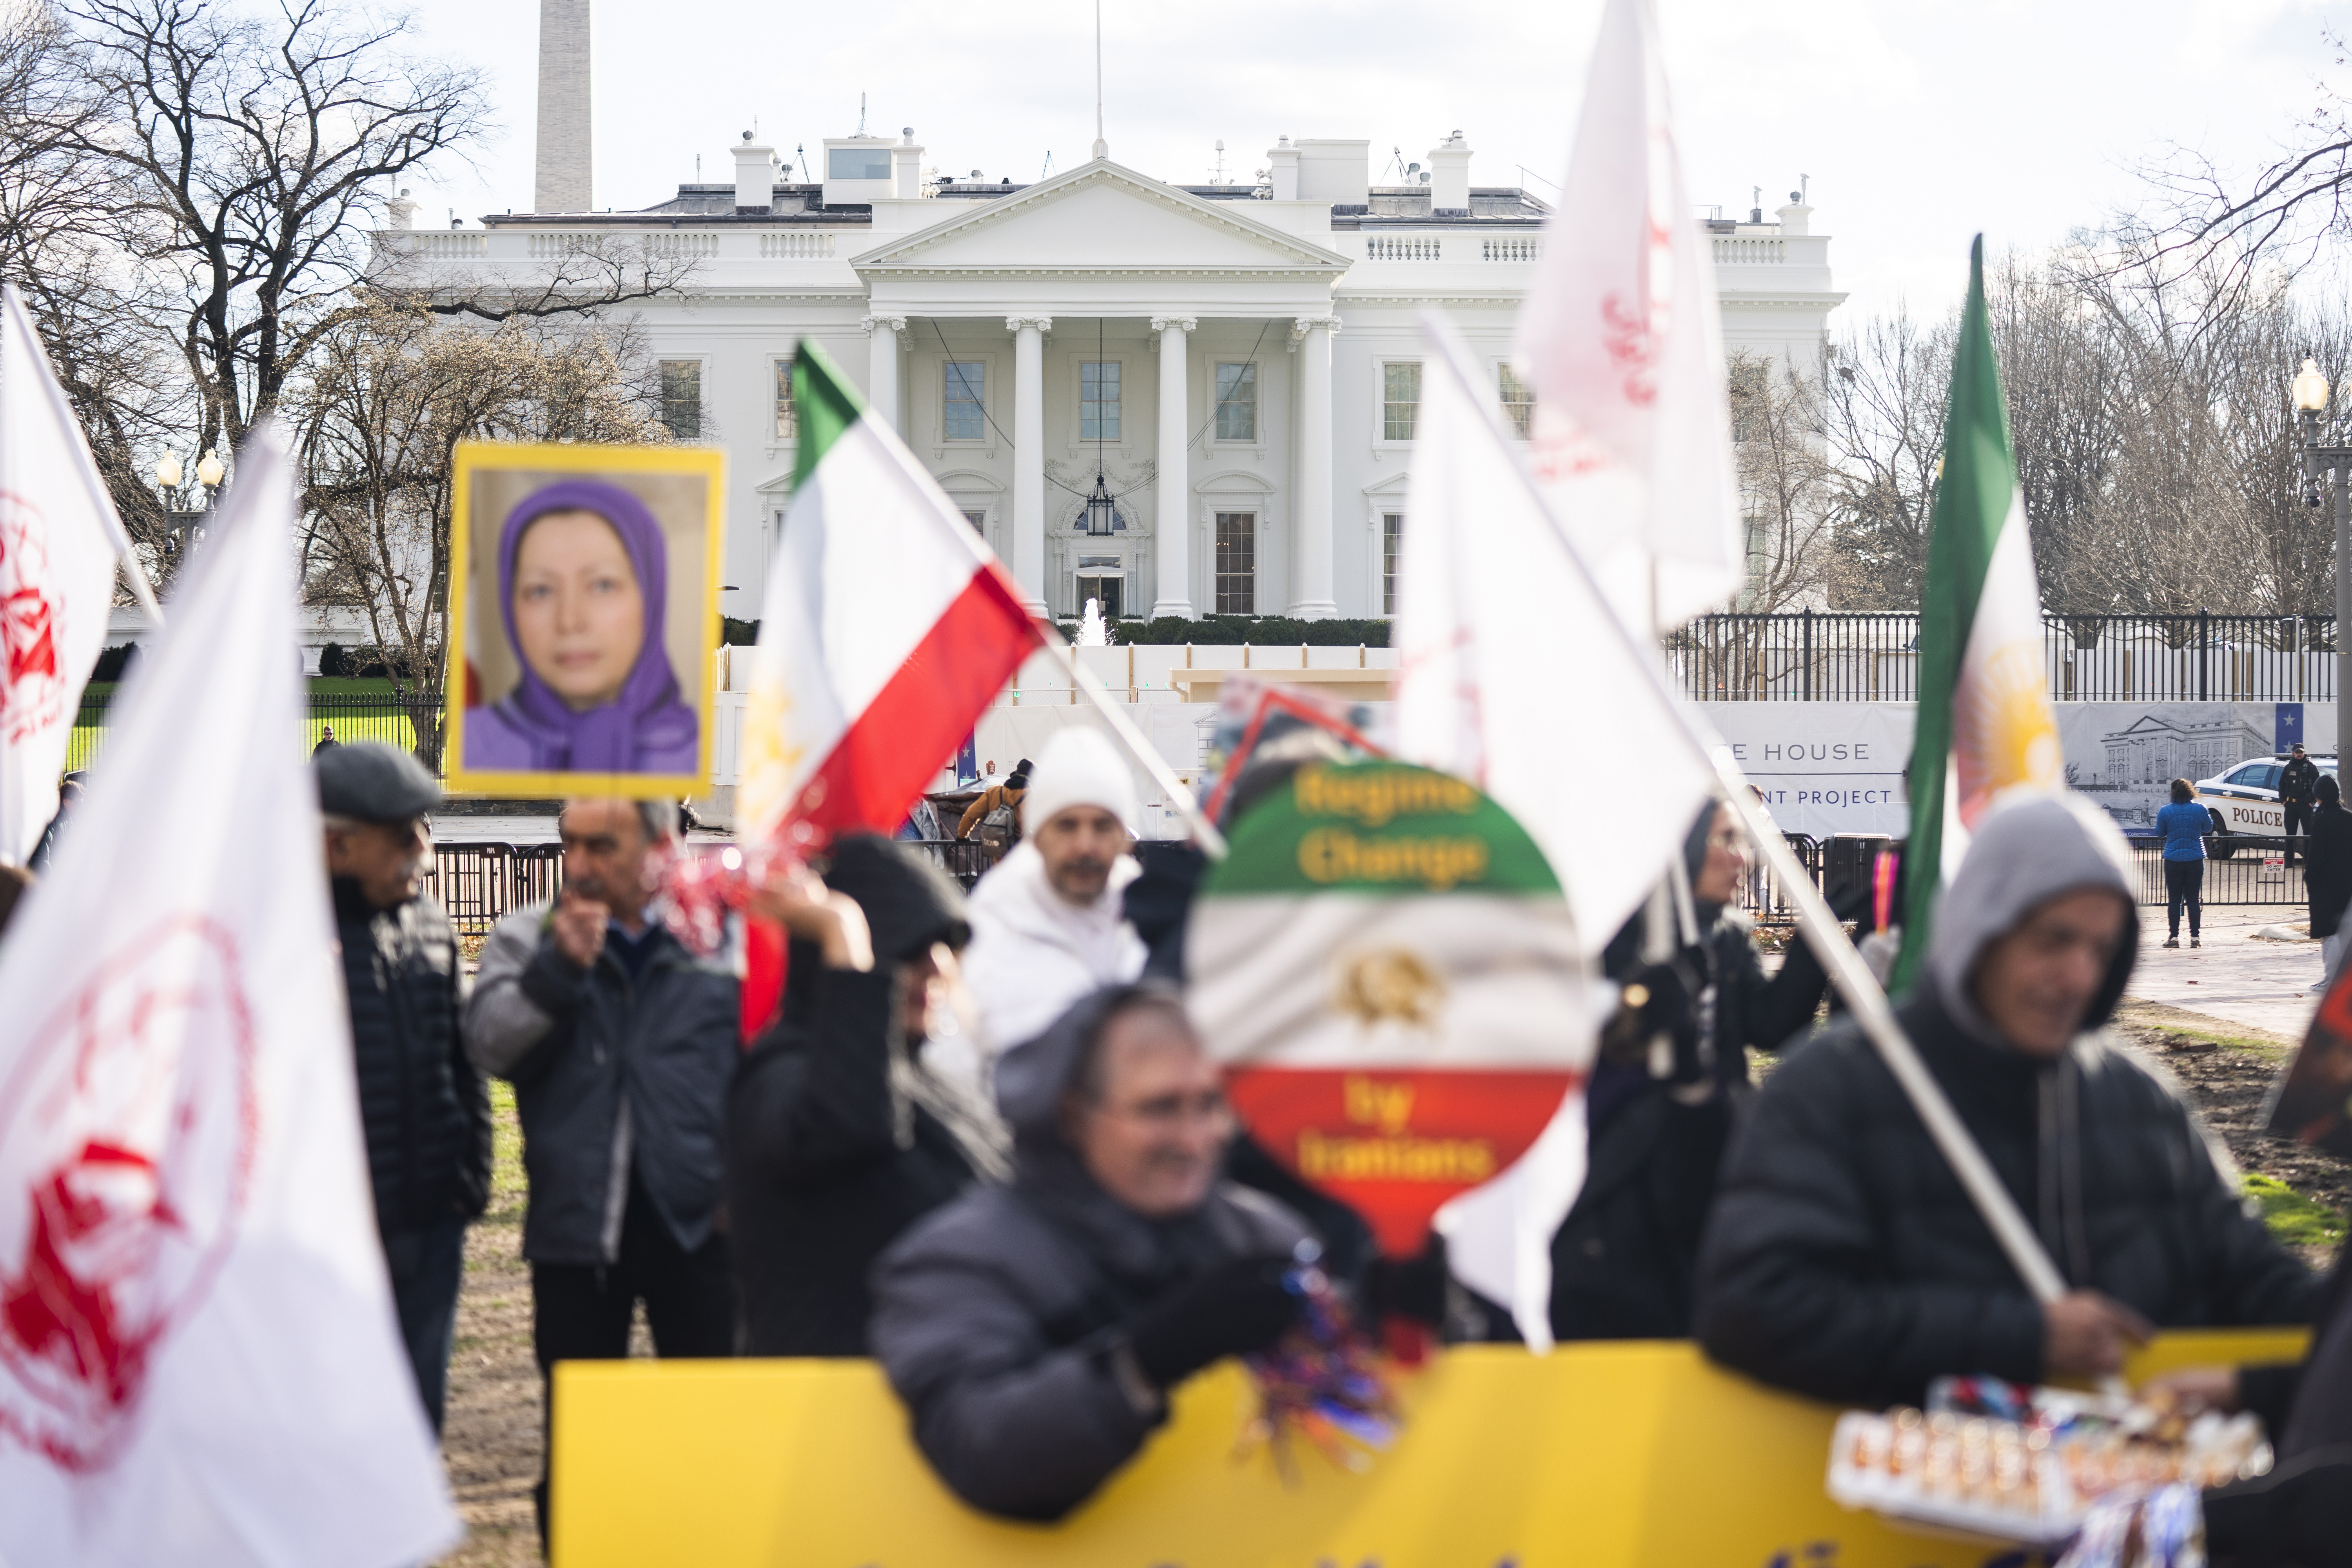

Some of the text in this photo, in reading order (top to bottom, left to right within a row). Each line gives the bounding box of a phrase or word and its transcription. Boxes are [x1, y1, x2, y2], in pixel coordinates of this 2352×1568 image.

[1764, 743, 1869, 760] HOUSE
[1294, 764, 1479, 826] Regime
[1798, 790, 1891, 808] PROJECT
[2232, 807, 2283, 827] POLICE
[1298, 827, 1488, 889] Change
[1343, 1073, 1414, 1134] by
[1299, 1130, 1494, 1180] Iranians
